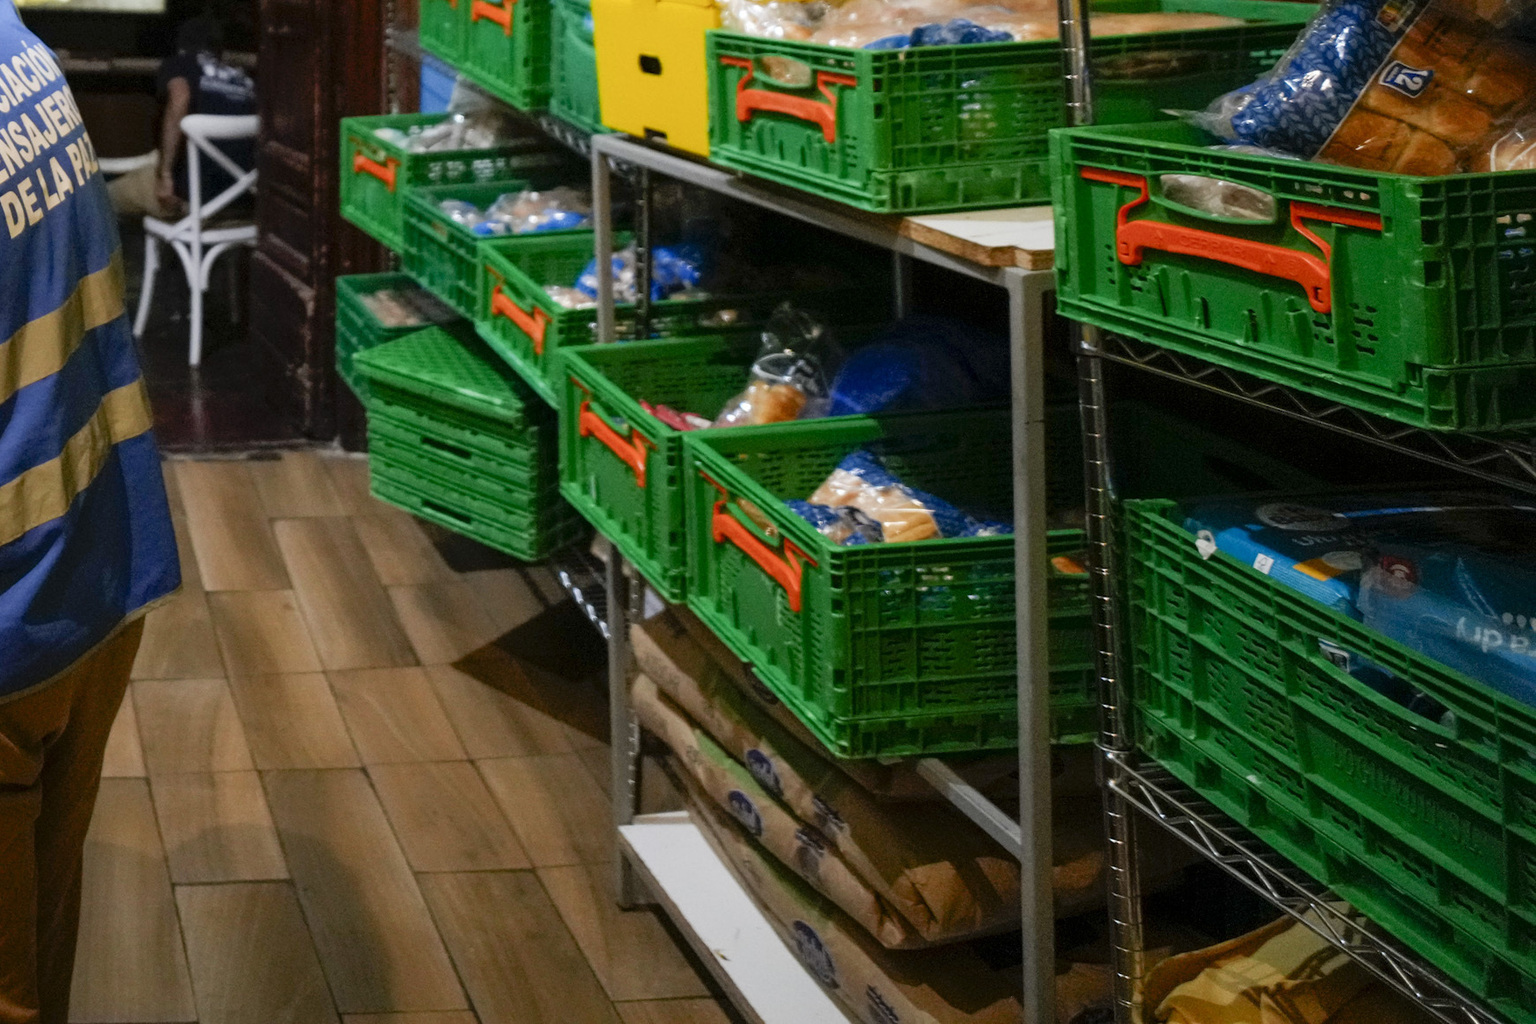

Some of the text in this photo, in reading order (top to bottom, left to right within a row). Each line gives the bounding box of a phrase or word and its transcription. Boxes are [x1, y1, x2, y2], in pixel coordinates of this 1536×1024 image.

[0, 132, 99, 239] DE LA PAZ
